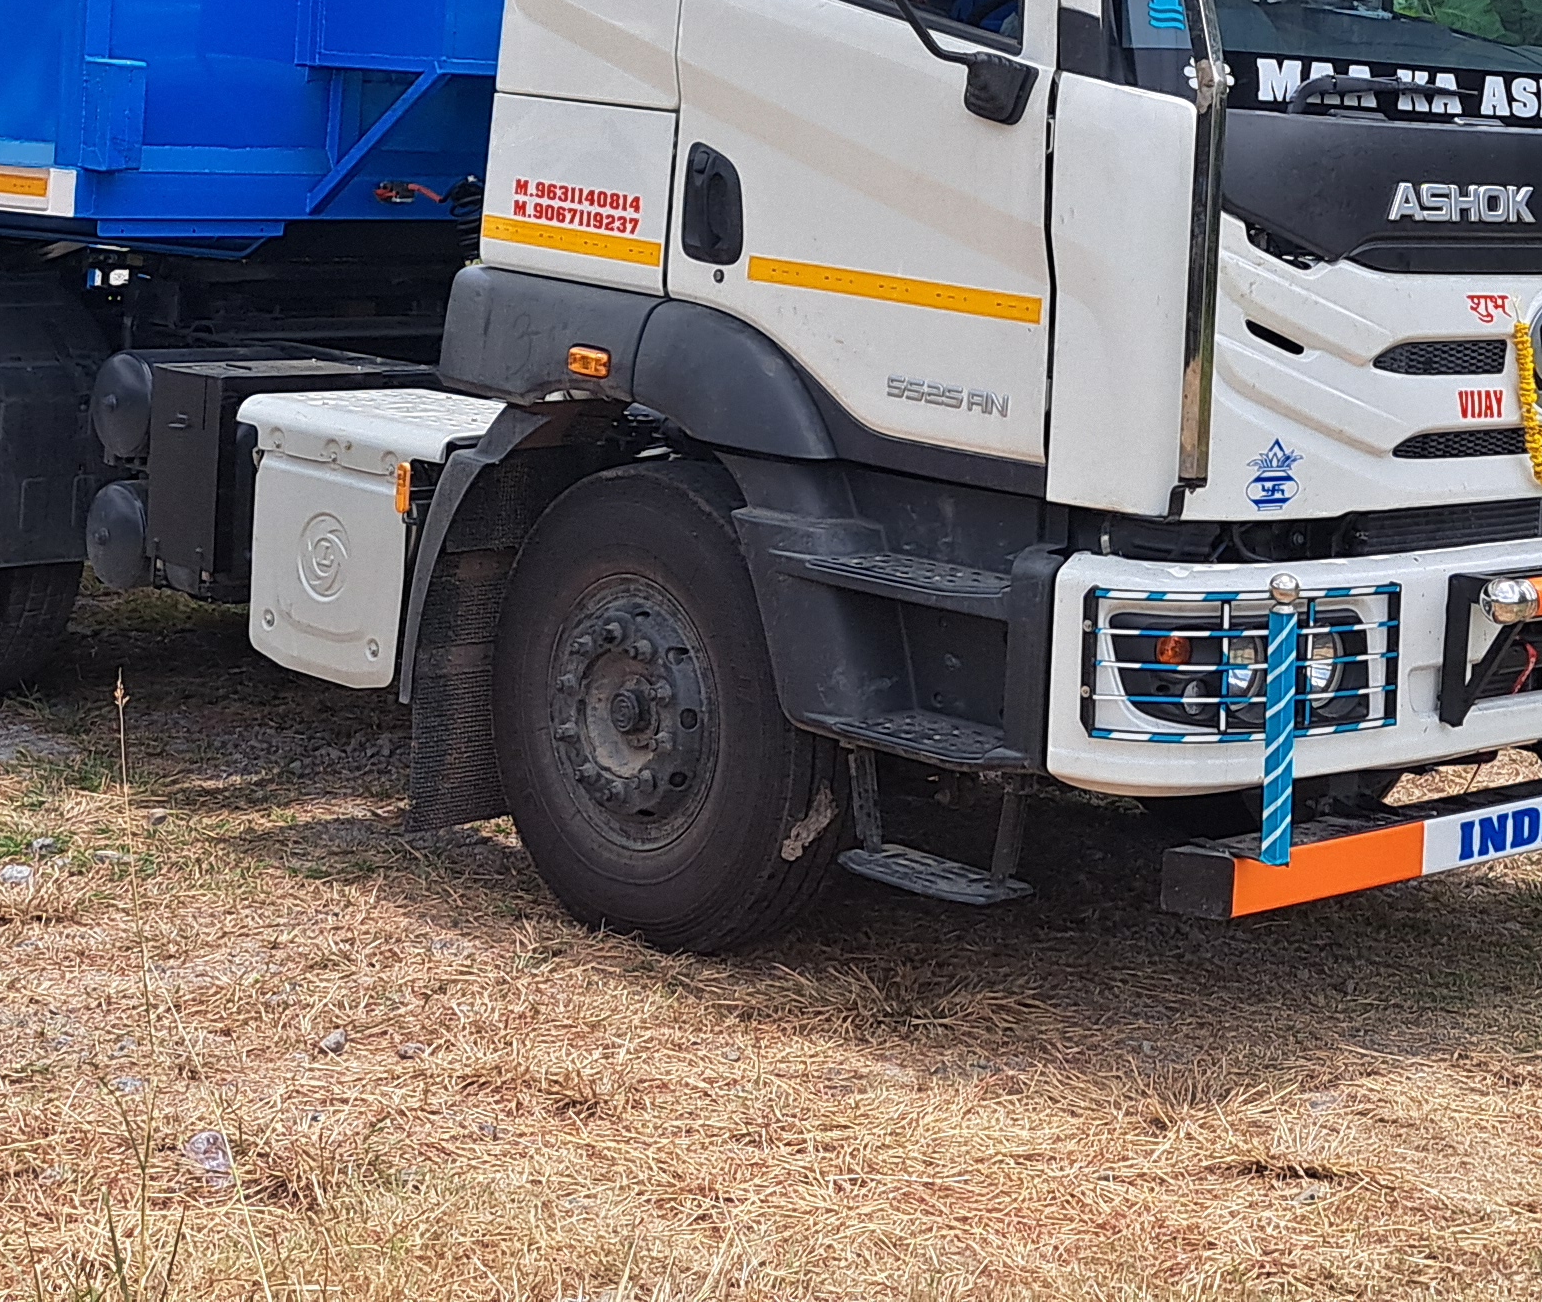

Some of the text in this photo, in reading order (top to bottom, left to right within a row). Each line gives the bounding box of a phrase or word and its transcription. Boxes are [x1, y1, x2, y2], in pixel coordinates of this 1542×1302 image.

[1256, 58, 1378, 109] MAA
[1396, 68, 1463, 116] KA
[513, 178, 641, 214] M.9631140814
[1387, 181, 1536, 225] ASHOK
[512, 199, 640, 235] M.9067119237
[1466, 294, 1512, 324] शुभ
[886, 373, 1009, 418] 5525 AN
[1457, 389, 1504, 419] VIJAY
